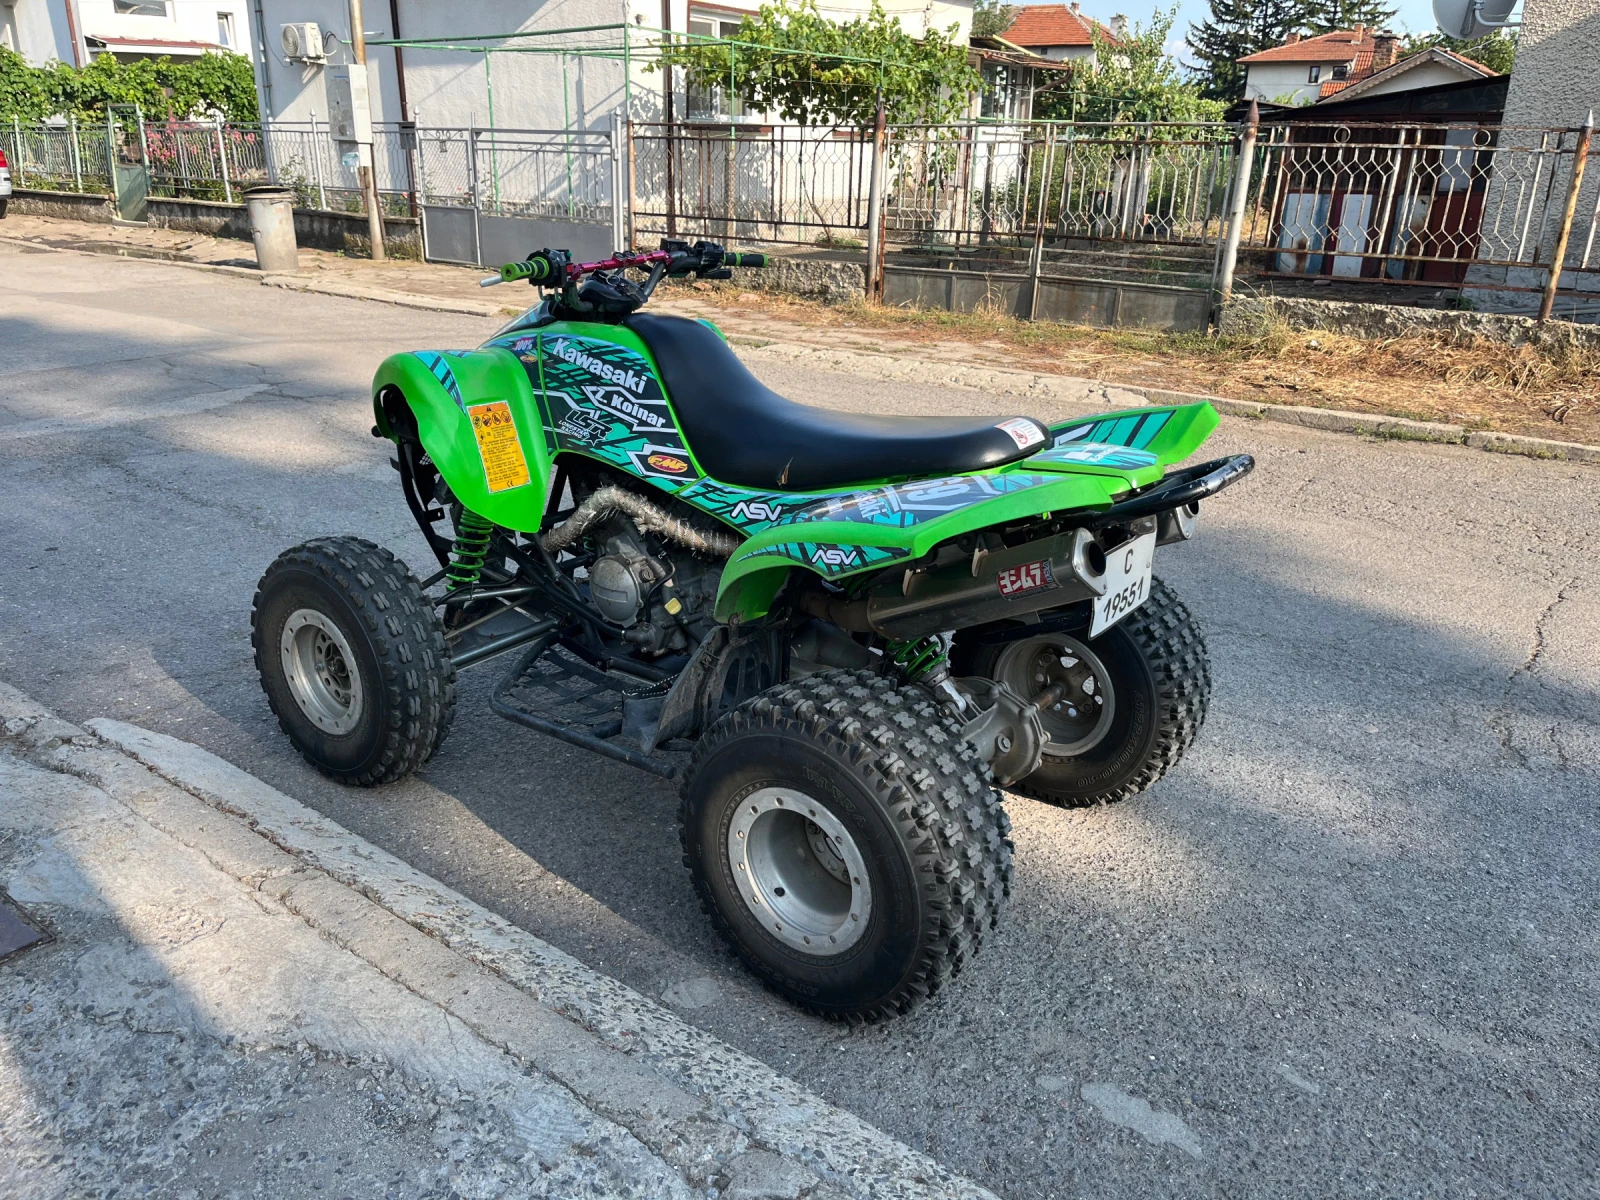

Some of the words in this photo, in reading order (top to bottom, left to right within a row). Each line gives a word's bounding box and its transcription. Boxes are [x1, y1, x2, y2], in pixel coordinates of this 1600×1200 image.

[553, 338, 648, 394] Kawasaki
[611, 394, 667, 428] Koinar
[648, 456, 688, 470] FMF
[731, 502, 783, 521] ASV
[811, 550, 857, 565] ASV
[1123, 549, 1134, 574] C
[1000, 563, 1042, 594] ヨシムラ
[1103, 576, 1144, 623] 19551
